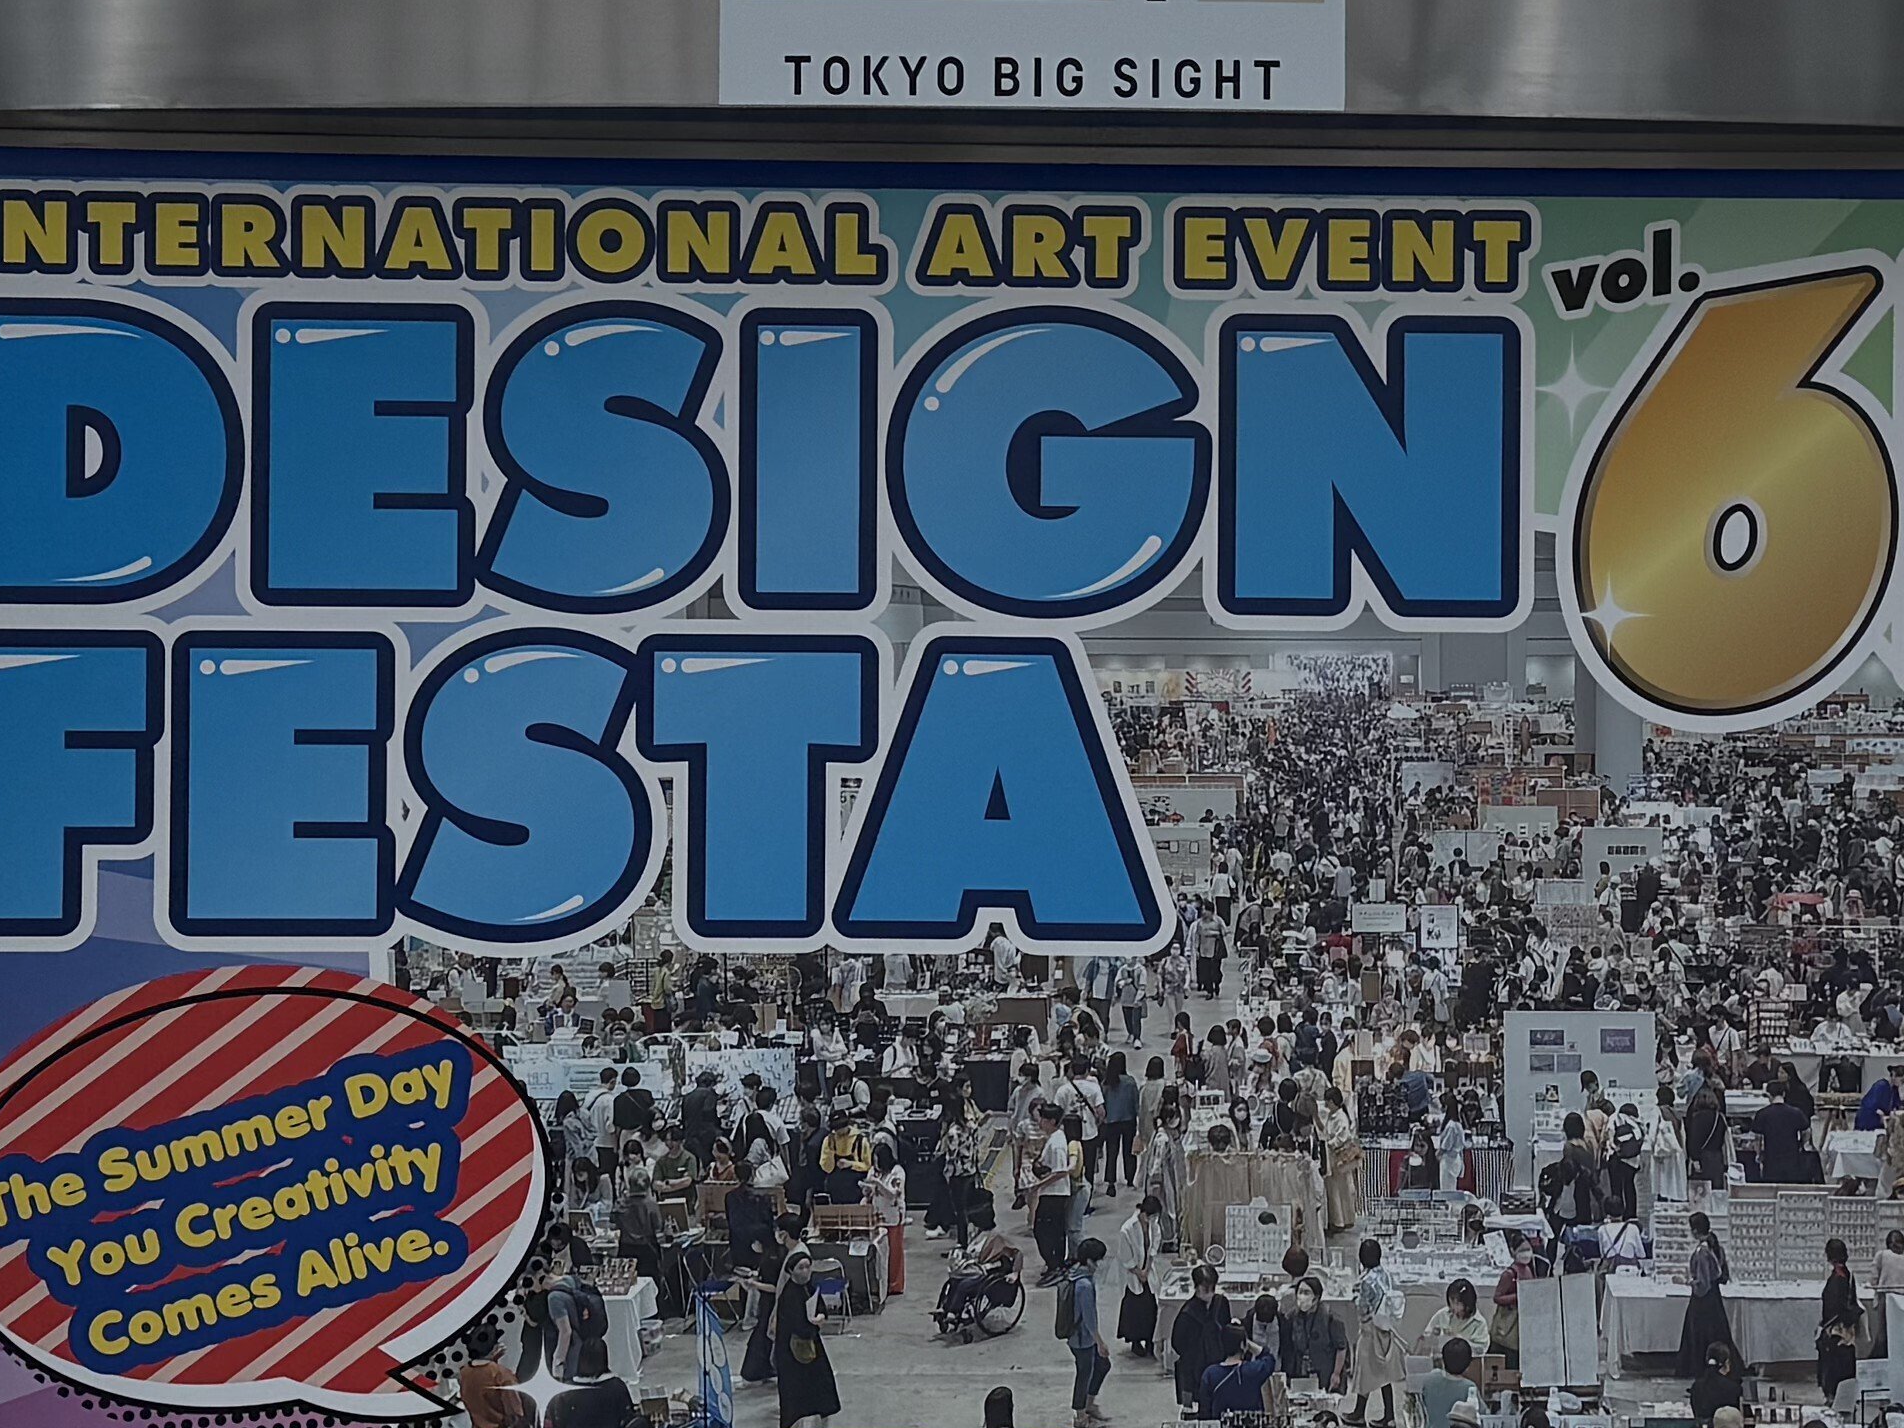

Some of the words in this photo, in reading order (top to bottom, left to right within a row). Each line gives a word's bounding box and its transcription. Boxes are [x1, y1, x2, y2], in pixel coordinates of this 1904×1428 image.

[784, 55, 965, 97] TOKYO
[993, 56, 1086, 98] BIG
[1113, 58, 1283, 102] SIGHT
[921, 205, 1138, 290] ART
[1173, 207, 1532, 296] EVENT
[1551, 227, 1701, 310] vol.
[98, 1097, 332, 1194] Summer
[345, 1059, 454, 1119] Day
[47, 1227, 160, 1286] You
[176, 1137, 443, 1248] Creativity
[92, 1273, 282, 1356] Comes
[295, 1230, 449, 1296] Alive.
